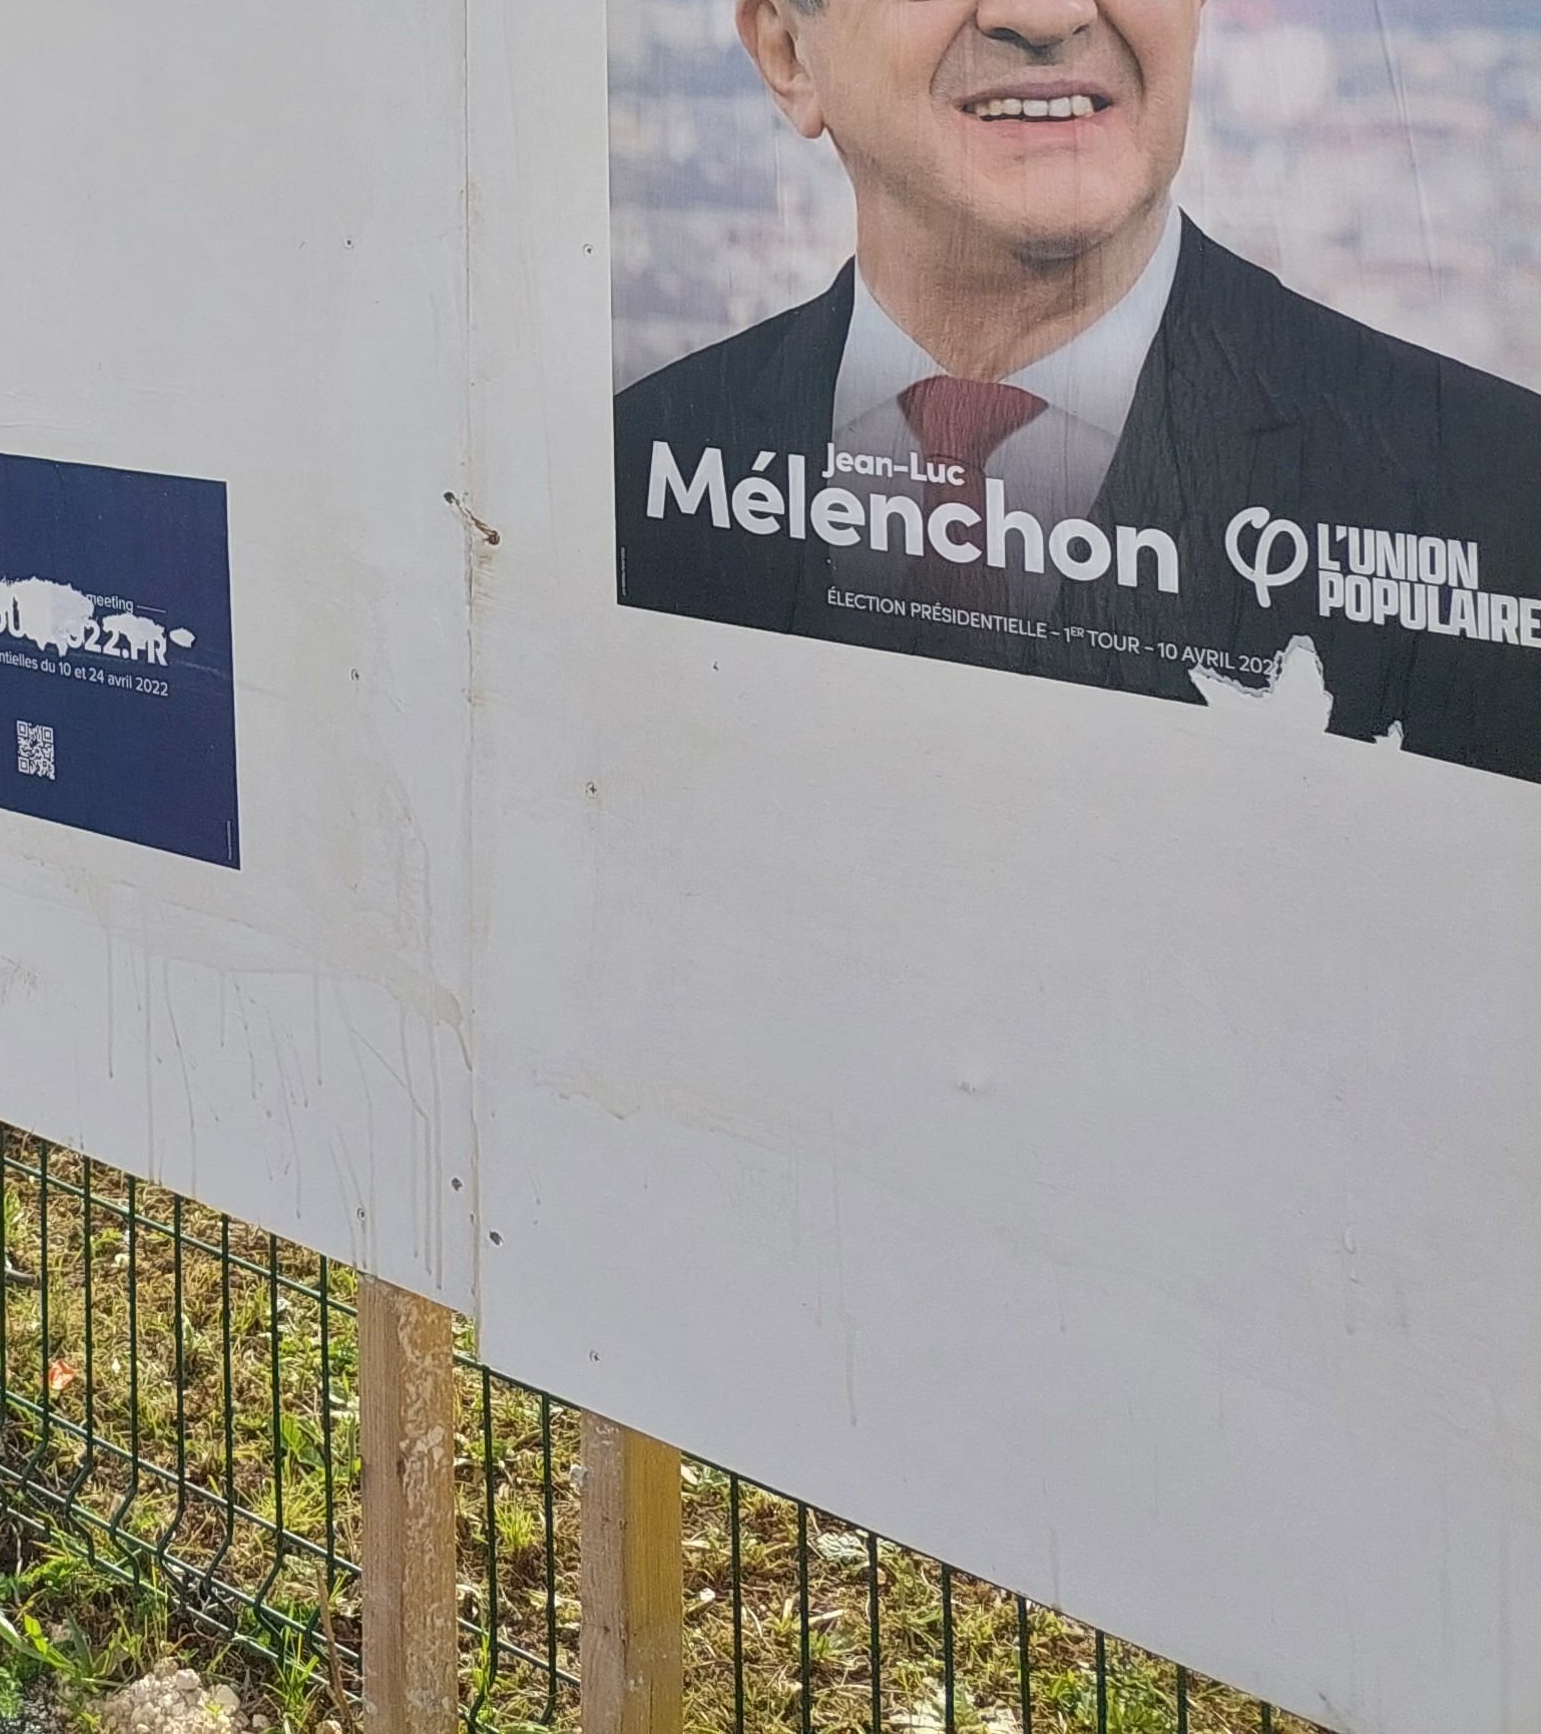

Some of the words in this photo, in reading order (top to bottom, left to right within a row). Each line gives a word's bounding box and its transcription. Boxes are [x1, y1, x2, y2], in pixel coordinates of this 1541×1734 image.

[820, 442, 966, 488] Jean-Luc
[645, 438, 1180, 595] Mélenchon
[1318, 521, 1480, 591] L'UNION
[85, 592, 135, 614] meeting
[826, 586, 907, 618] ÉLECTION
[908, 599, 1049, 641] PRÉSIDENTIELLE
[1086, 630, 1141, 655] TOUR
[1157, 642, 1179, 661] 10
[1181, 646, 1236, 670] AVRIL
[1319, 572, 1541, 650] POPULAIRE
[40, 661, 56, 674] du
[59, 662, 72, 677] 10
[74, 666, 87, 681] et
[88, 667, 104, 684] 24
[107, 670, 133, 690] avril
[135, 676, 169, 697] 2022
